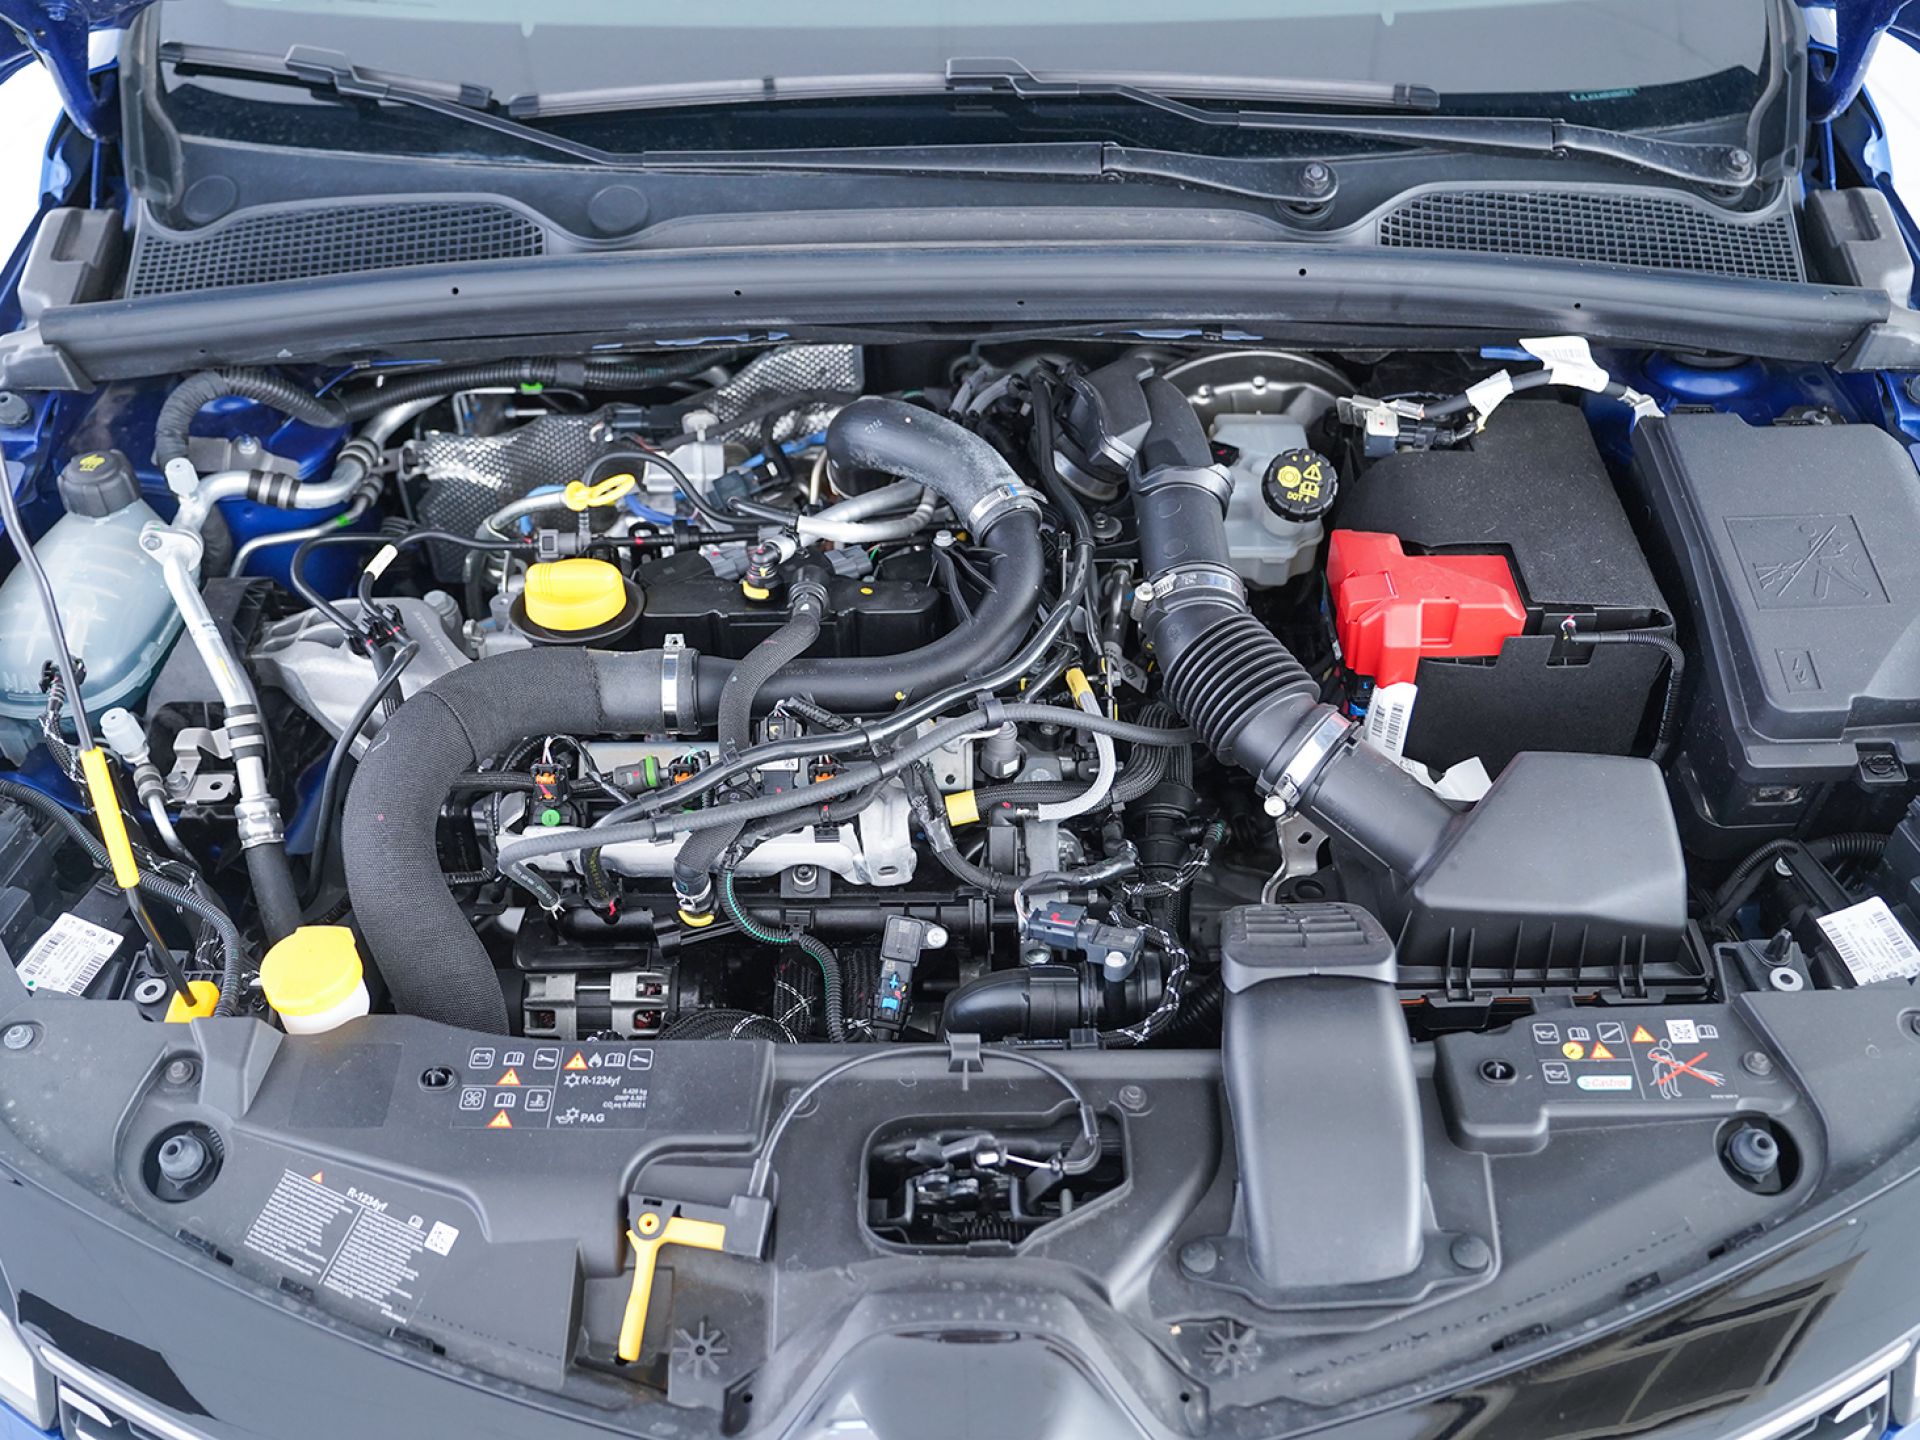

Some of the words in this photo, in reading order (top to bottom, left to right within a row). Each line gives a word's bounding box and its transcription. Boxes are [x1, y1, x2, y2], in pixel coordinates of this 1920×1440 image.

[1287, 491, 1304, 502] DOT
[1304, 496, 1311, 504] 4
[581, 1075, 621, 1087] R-1234yf
[1591, 1077, 1628, 1088] Castrol
[580, 1113, 606, 1123] PAG
[346, 1187, 388, 1212] R-1234yf
